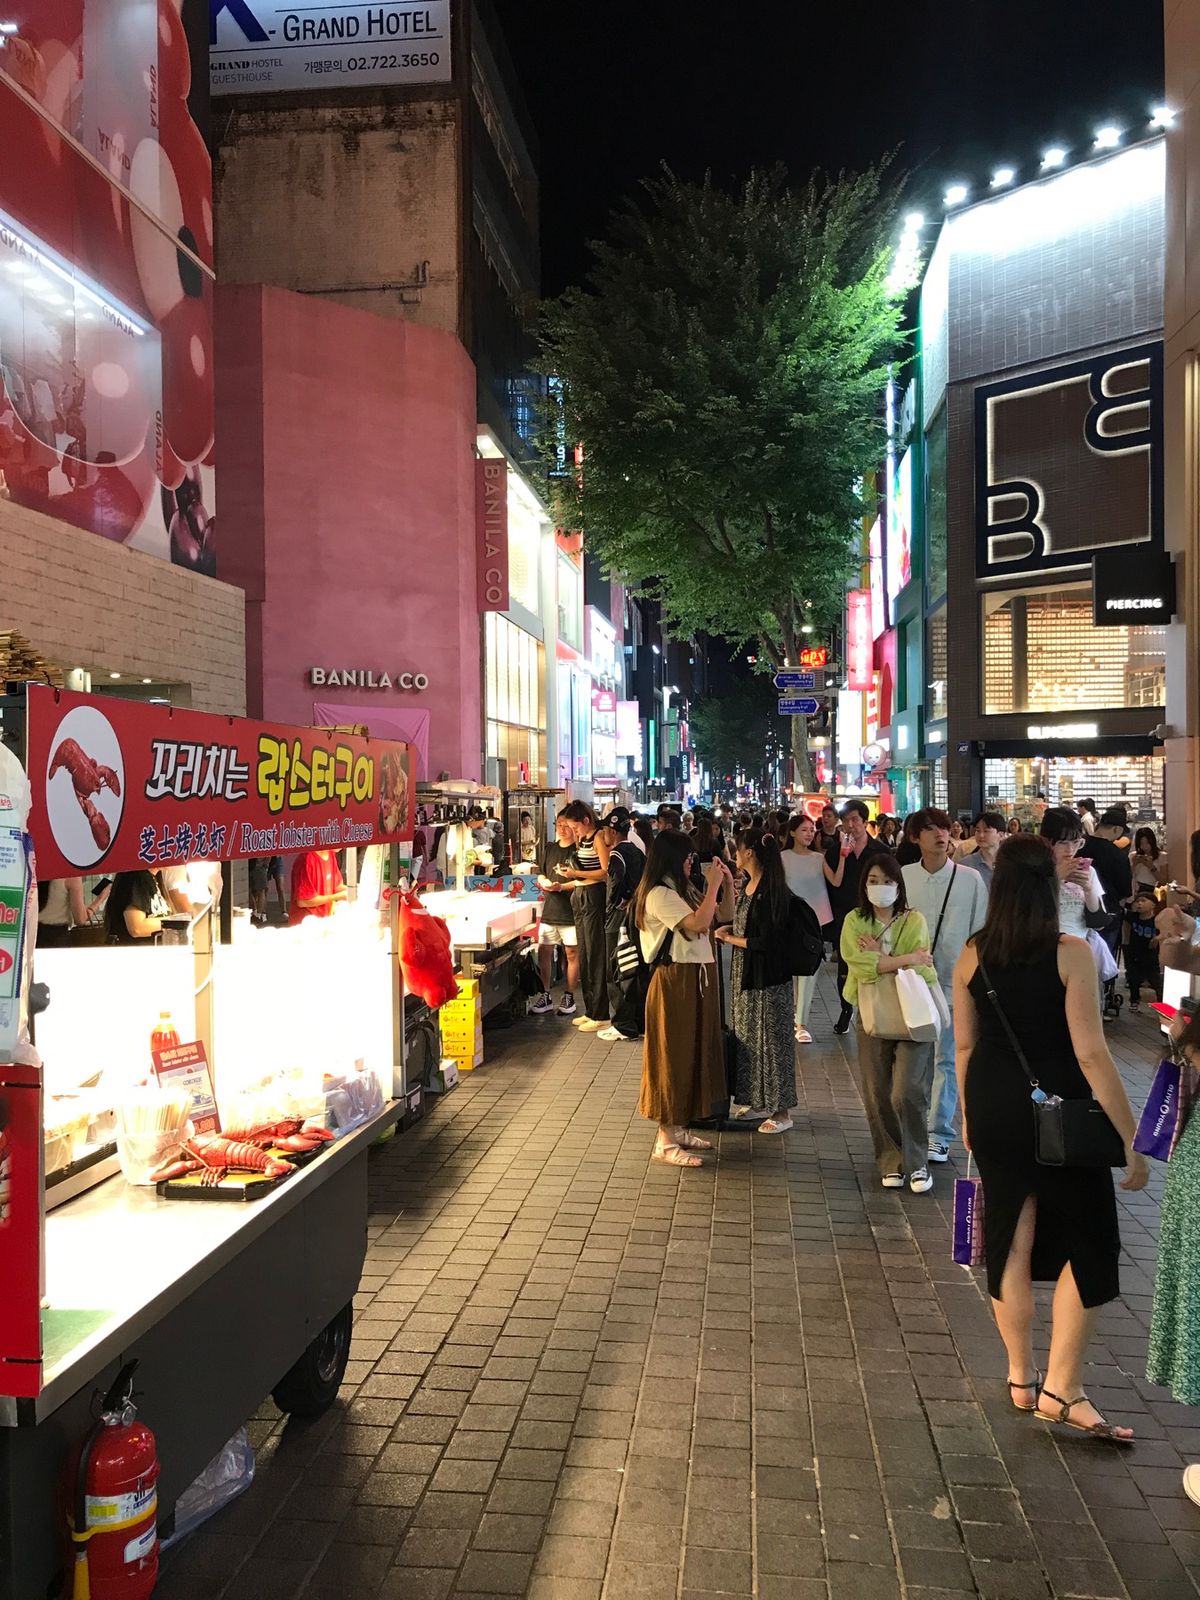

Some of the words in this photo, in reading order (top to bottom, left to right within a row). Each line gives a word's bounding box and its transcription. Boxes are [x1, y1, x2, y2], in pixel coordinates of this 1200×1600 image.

[283, 14, 359, 42] GRAND
[367, 9, 437, 36] HOTEL
[210, 60, 250, 71] GRAND
[251, 58, 284, 68] HOSTEL
[212, 71, 274, 84] GUESTHOUSE
[484, 464, 501, 559] BANILA
[485, 567, 503, 604] CO
[1106, 598, 1163, 610] PIERCING
[312, 667, 393, 688] BANILA
[400, 672, 429, 690] CO
[145, 740, 249, 800] 꼬리치는
[258, 734, 375, 813] 랍스터구이
[138, 821, 226, 863] 芝士烤龙虾
[240, 823, 278, 851] Roast
[279, 821, 318, 850] lobster
[318, 817, 341, 845] with
[342, 815, 374, 842] Cheese
[1163, 1084, 1175, 1105] OLIVE
[1152, 1114, 1167, 1137] YOUNG
